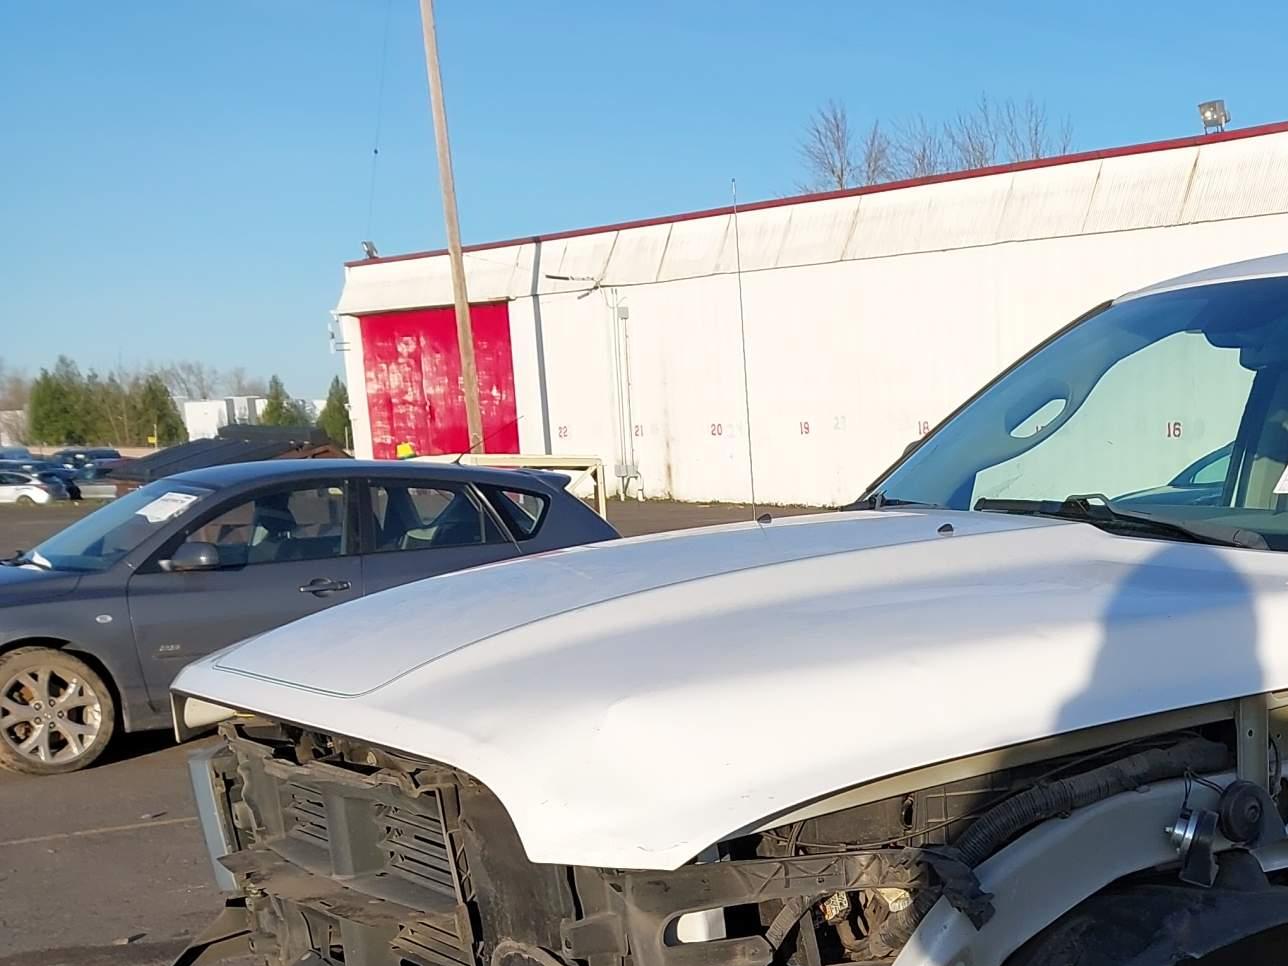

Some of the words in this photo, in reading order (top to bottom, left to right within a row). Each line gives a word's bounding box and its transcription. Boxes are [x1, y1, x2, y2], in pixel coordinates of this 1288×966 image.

[558, 426, 568, 438] 22
[634, 425, 643, 437] 21
[710, 423, 723, 436] 20
[800, 421, 810, 435] 19
[1167, 422, 1181, 437] 16
